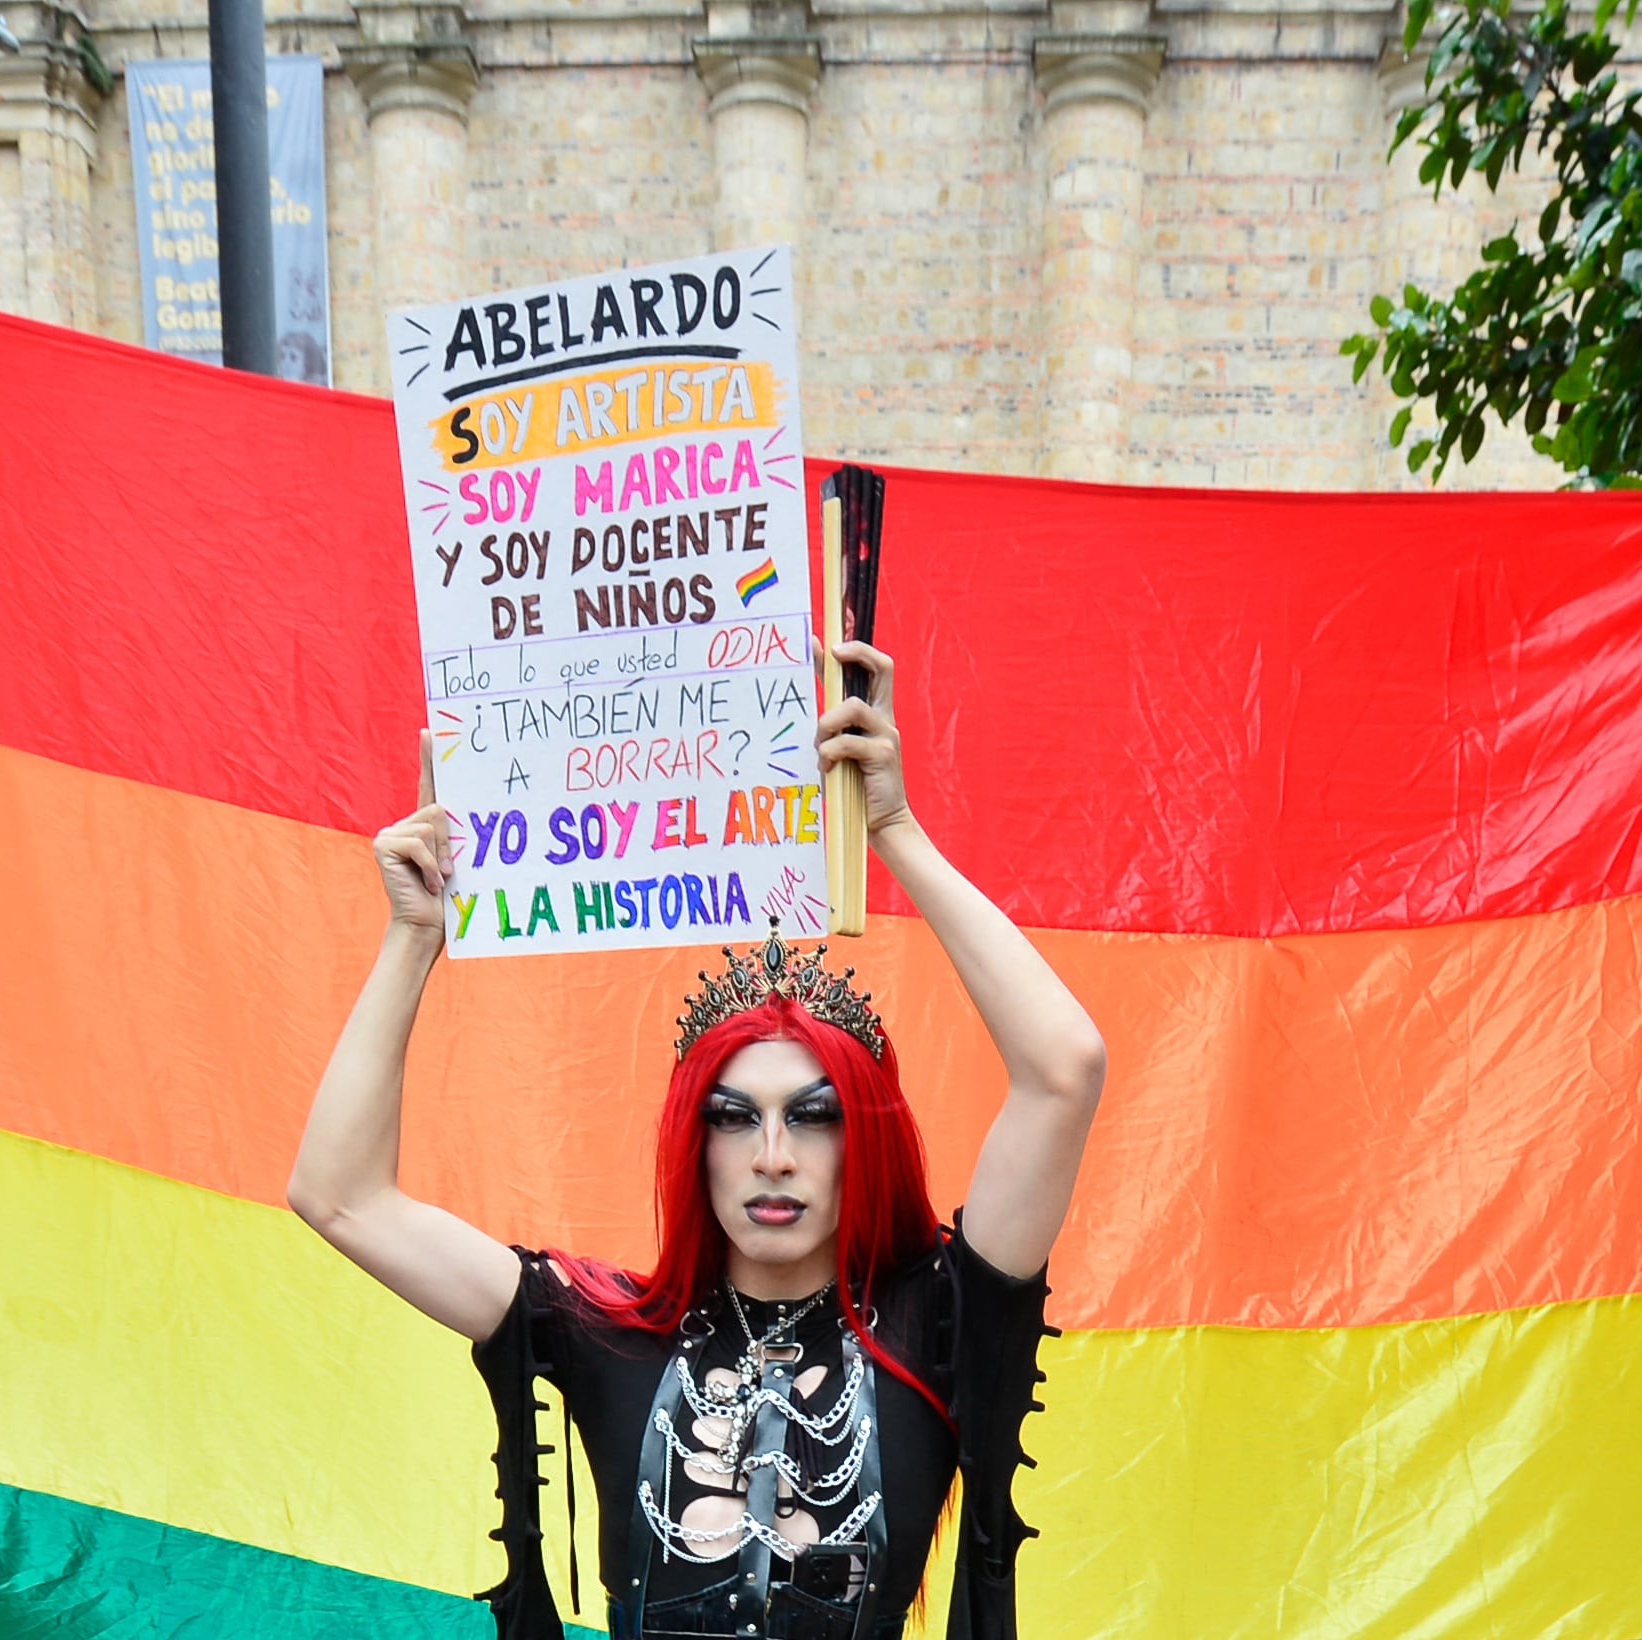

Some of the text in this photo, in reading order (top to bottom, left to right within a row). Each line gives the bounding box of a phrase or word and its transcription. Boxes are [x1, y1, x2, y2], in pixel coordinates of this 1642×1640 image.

[444, 266, 741, 372] ABELARDO
[451, 365, 757, 464] SOY ARTISTA
[459, 439, 762, 525] SOY MARICA
[435, 503, 768, 587] Y SOY DOCENTE
[491, 569, 717, 640] DE NIÑOS
[432, 623, 801, 698] Todo lo que usted ODIA
[470, 677, 808, 753] ¿TAMBIÉN ME VA
[504, 729, 751, 795] A BORRAR?
[469, 784, 821, 869] YO SOY EL ARTE
[451, 871, 752, 941] Y LA HISTORIA
